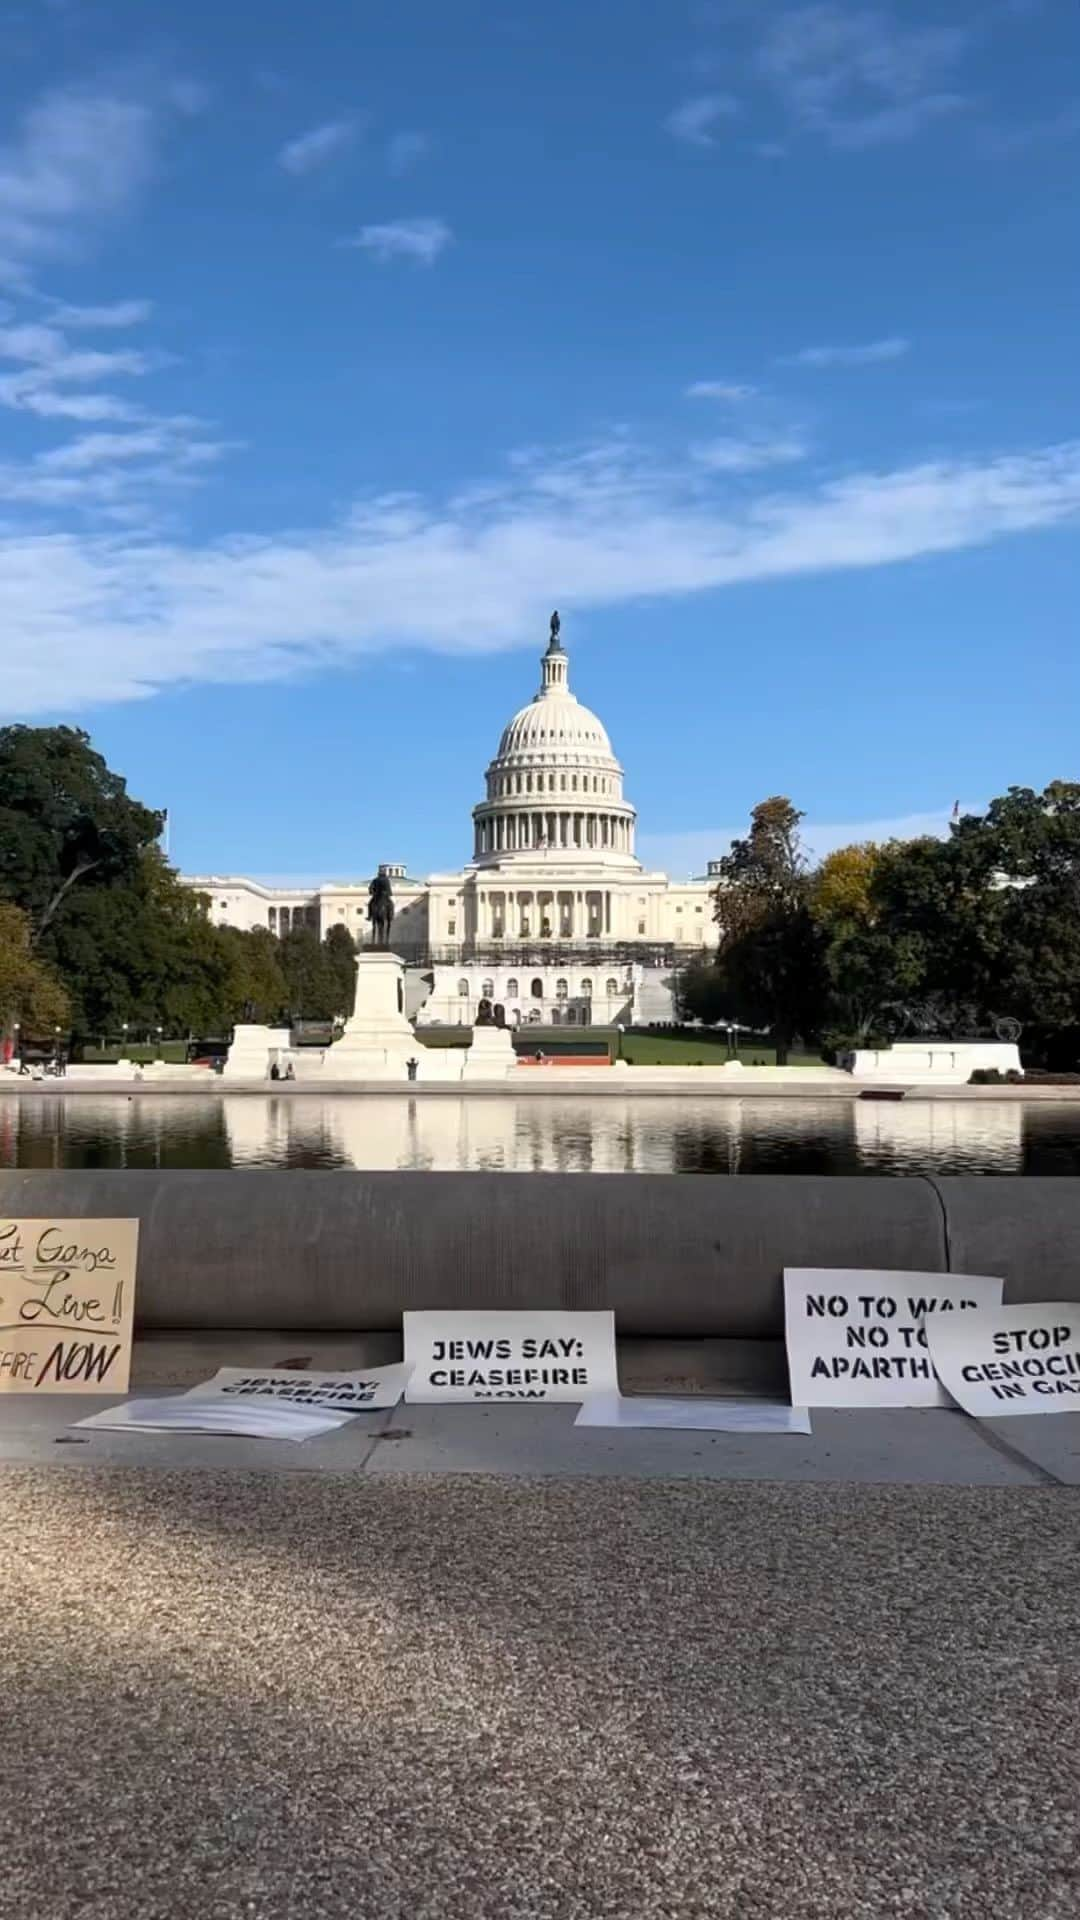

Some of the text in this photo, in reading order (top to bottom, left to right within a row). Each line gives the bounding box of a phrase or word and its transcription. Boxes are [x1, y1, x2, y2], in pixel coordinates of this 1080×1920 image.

[36, 1228, 116, 1272] Gaza
[806, 1295, 848, 1318] NO
[858, 1296, 897, 1318] TO
[846, 1326, 889, 1348] NO
[993, 1326, 1071, 1354] STOP
[432, 1337, 584, 1361] JEWS SAY:
[0, 1342, 121, 1387] FIRE NOW
[811, 1357, 938, 1378] APARTH
[430, 1368, 587, 1388] CEASEFIRE
[221, 1386, 376, 1402] CEASEFIRE
[991, 1382, 1027, 1399] IN
